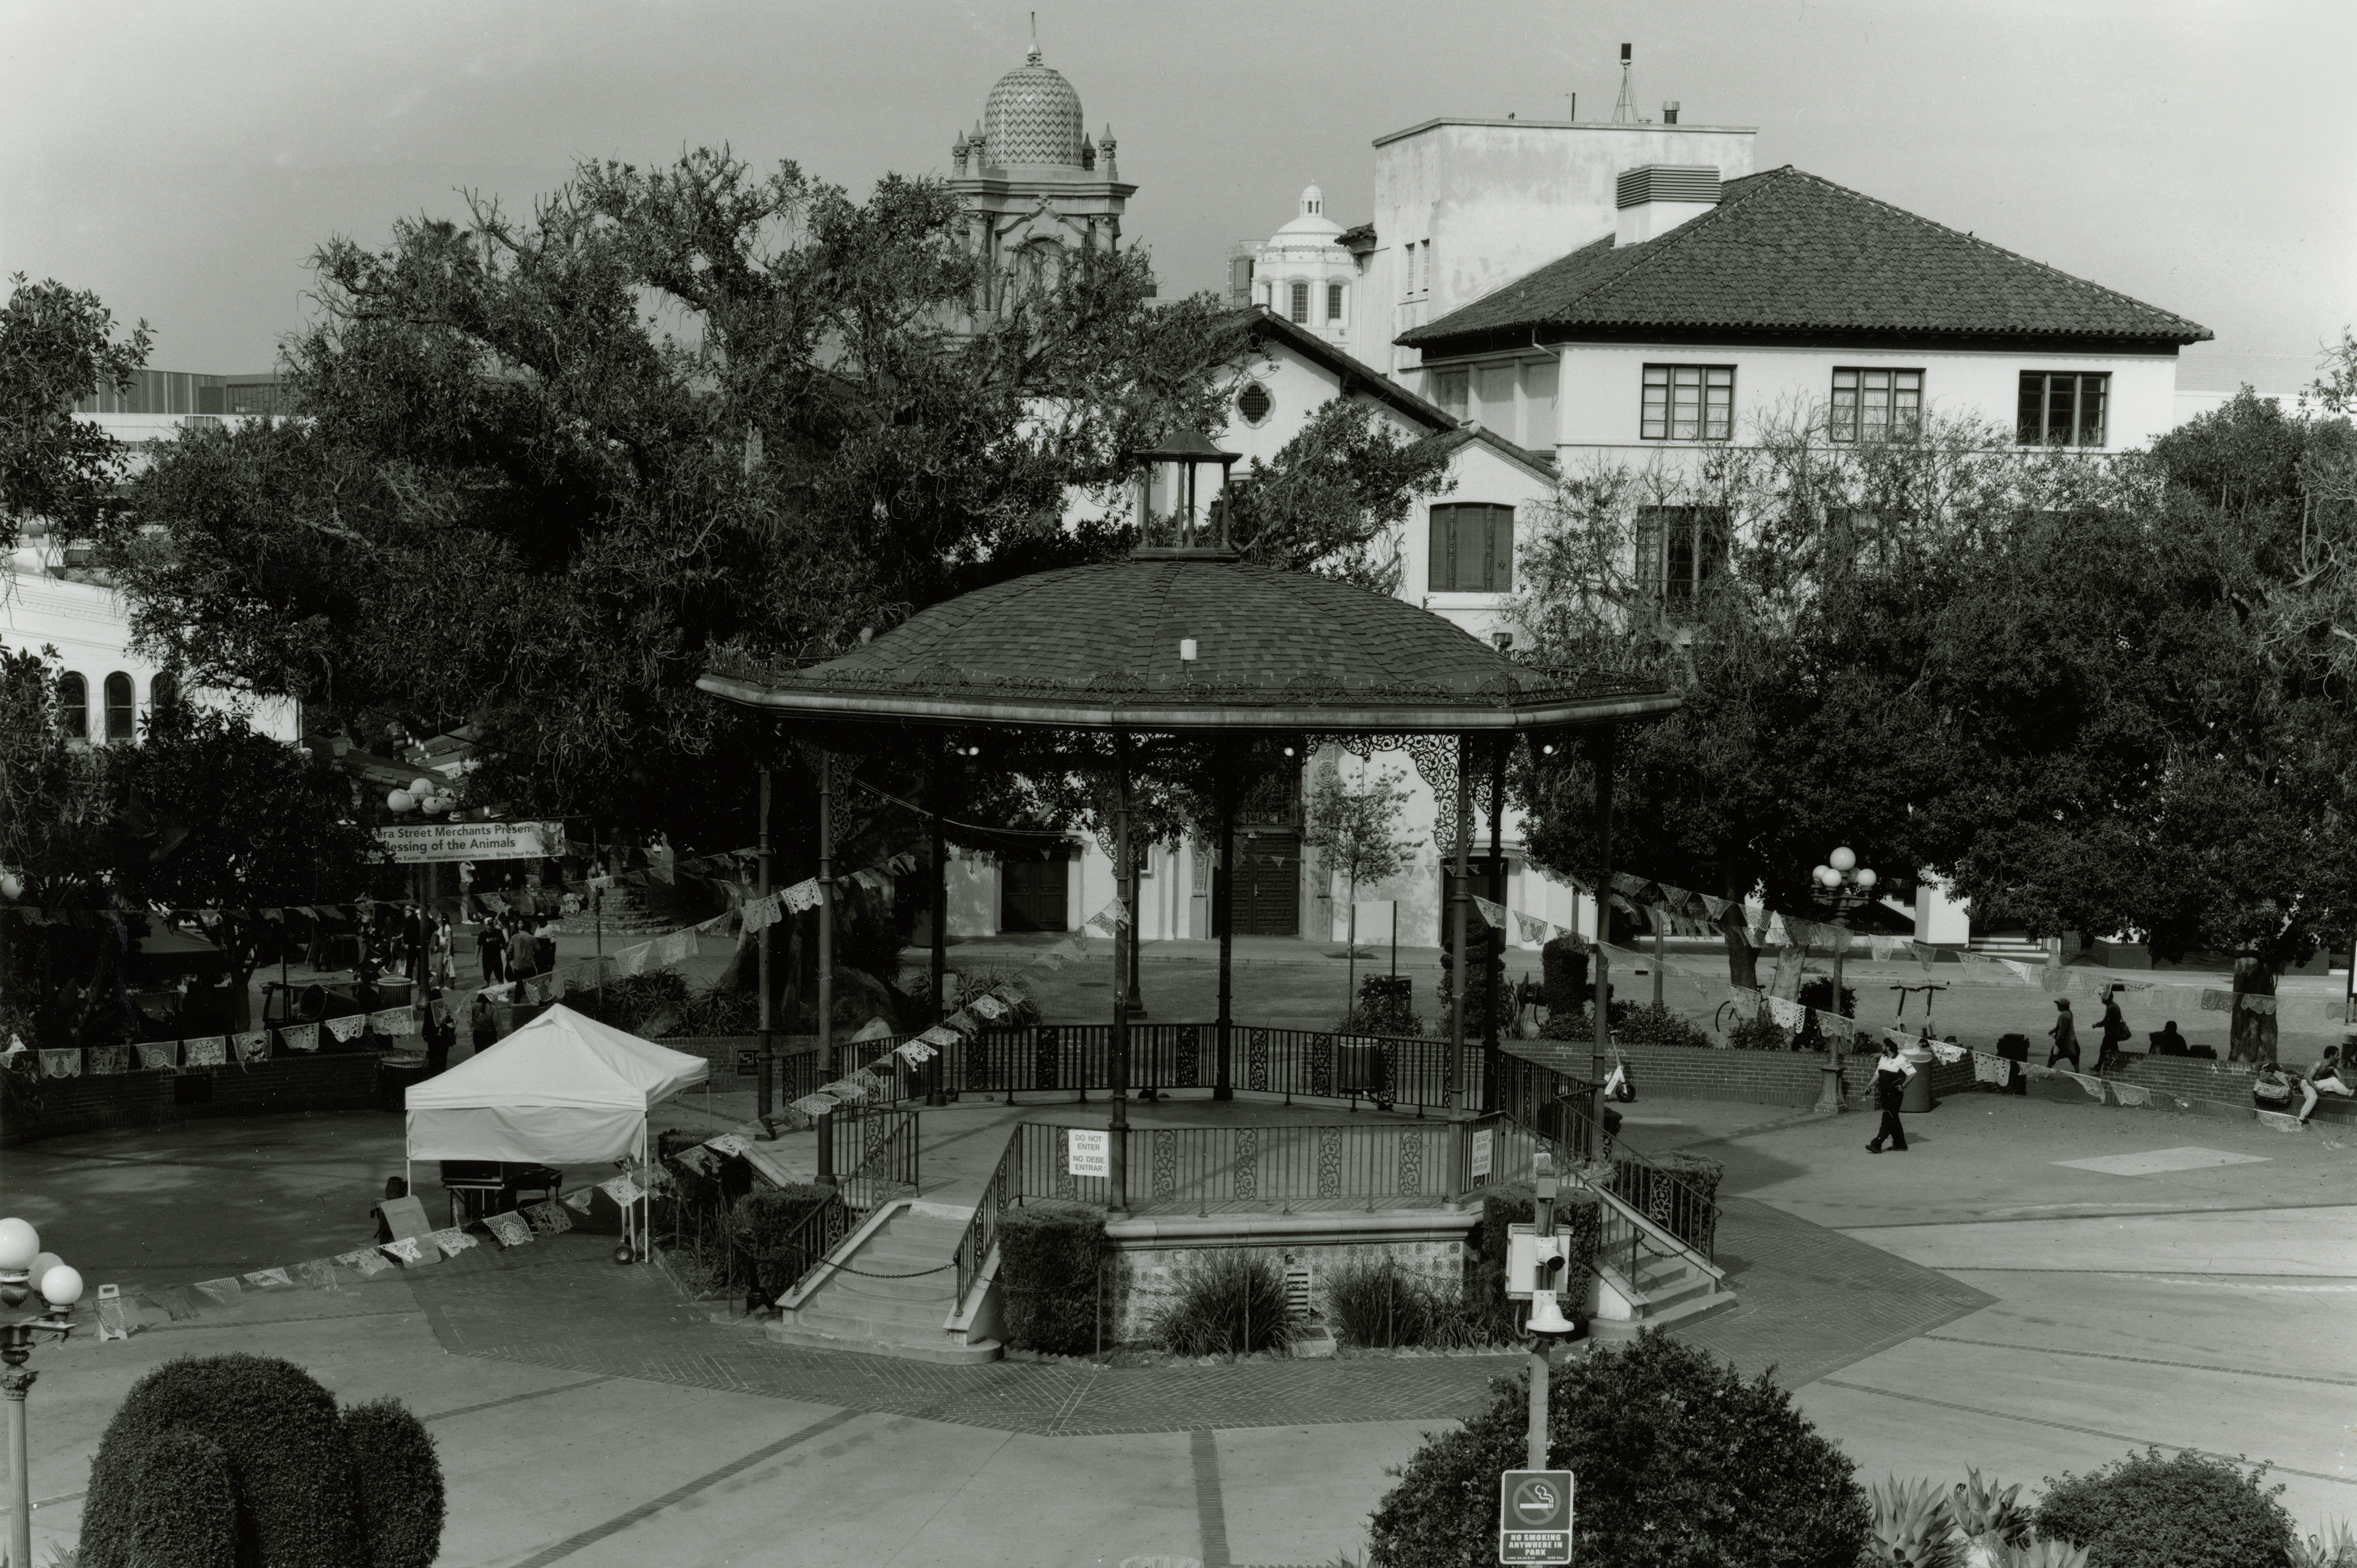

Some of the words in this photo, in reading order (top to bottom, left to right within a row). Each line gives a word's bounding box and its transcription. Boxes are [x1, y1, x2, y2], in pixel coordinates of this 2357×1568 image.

[398, 828, 432, 838] Street
[435, 825, 491, 836] Merchants
[495, 825, 530, 834] Presen
[387, 840, 427, 854] lessing
[432, 839, 443, 851] of
[447, 839, 466, 849] the
[470, 836, 516, 849] Animals
[1476, 1143, 1488, 1151] ENTER
